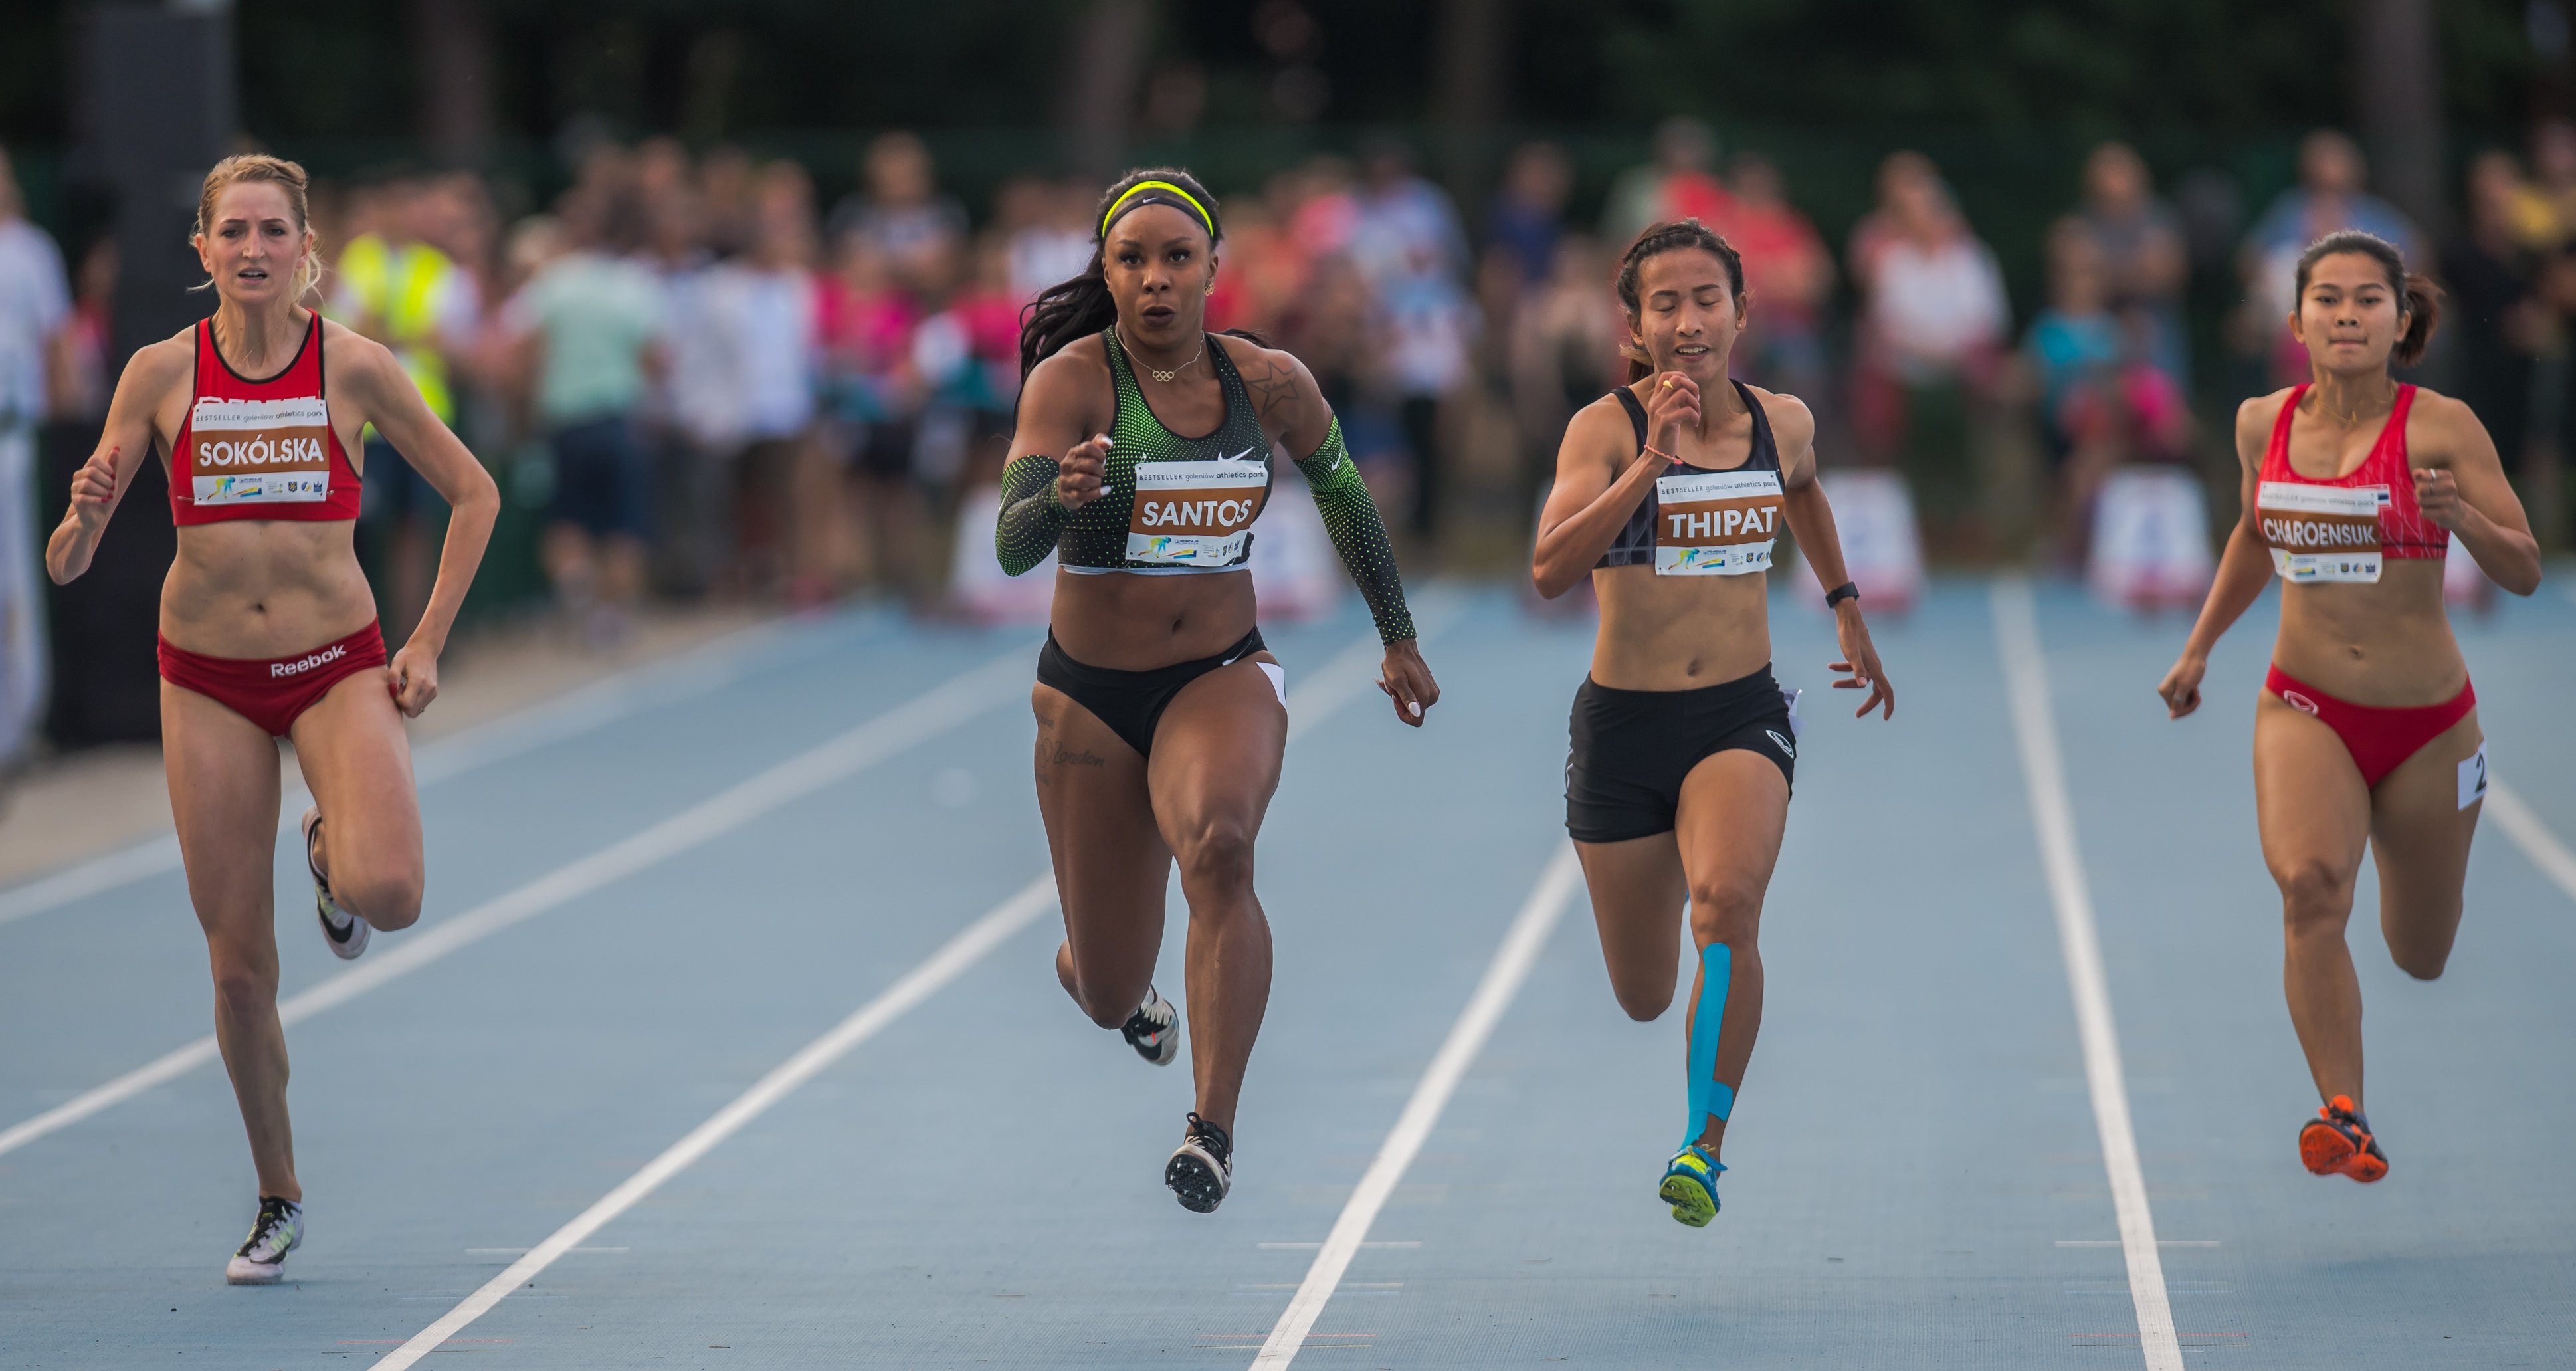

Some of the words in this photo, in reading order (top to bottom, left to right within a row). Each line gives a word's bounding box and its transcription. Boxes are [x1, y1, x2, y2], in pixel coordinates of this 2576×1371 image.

[244, 413, 274, 422] goleniów
[276, 409, 305, 419] athletics
[199, 434, 324, 466] SOKÓLSKA
[1185, 473, 1215, 482] goleniów
[1248, 471, 1264, 480] park
[1706, 483, 1733, 493] goleniów
[1734, 480, 1761, 489] athletics
[1141, 499, 1252, 526] SANTOS
[2357, 499, 2375, 508] park
[1668, 506, 1777, 538] THIPAT
[2264, 518, 2376, 546] CHAROENSUK
[270, 645, 347, 678] Reebok
[1052, 740, 1104, 768] London
[2475, 752, 2486, 792] 2
